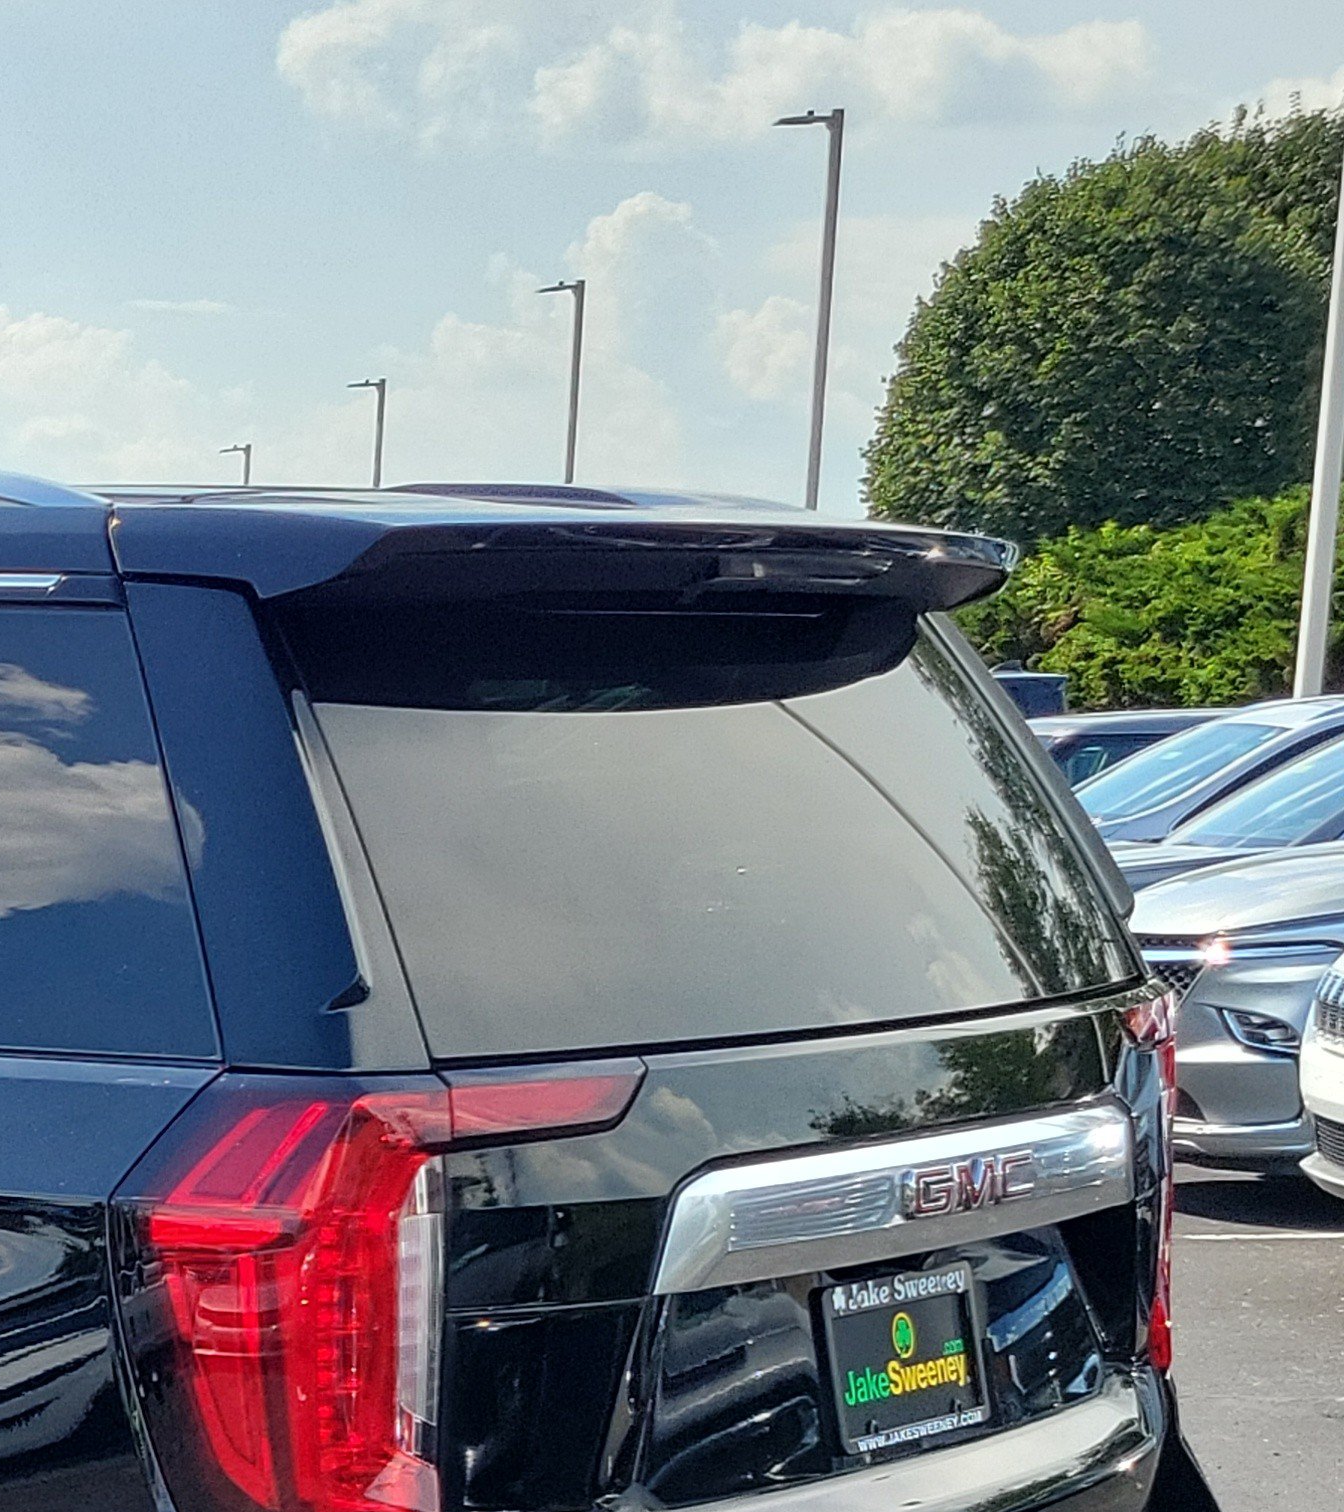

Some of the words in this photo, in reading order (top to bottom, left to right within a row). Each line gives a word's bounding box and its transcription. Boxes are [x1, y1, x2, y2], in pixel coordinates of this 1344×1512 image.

[908, 1151, 1034, 1218] GMC
[849, 1276, 890, 1312] Jake
[942, 1339, 964, 1355] .com
[845, 1353, 967, 1407] JakeSweeney
[858, 1409, 983, 1452] WWW.JAKESWEENEY.COM
